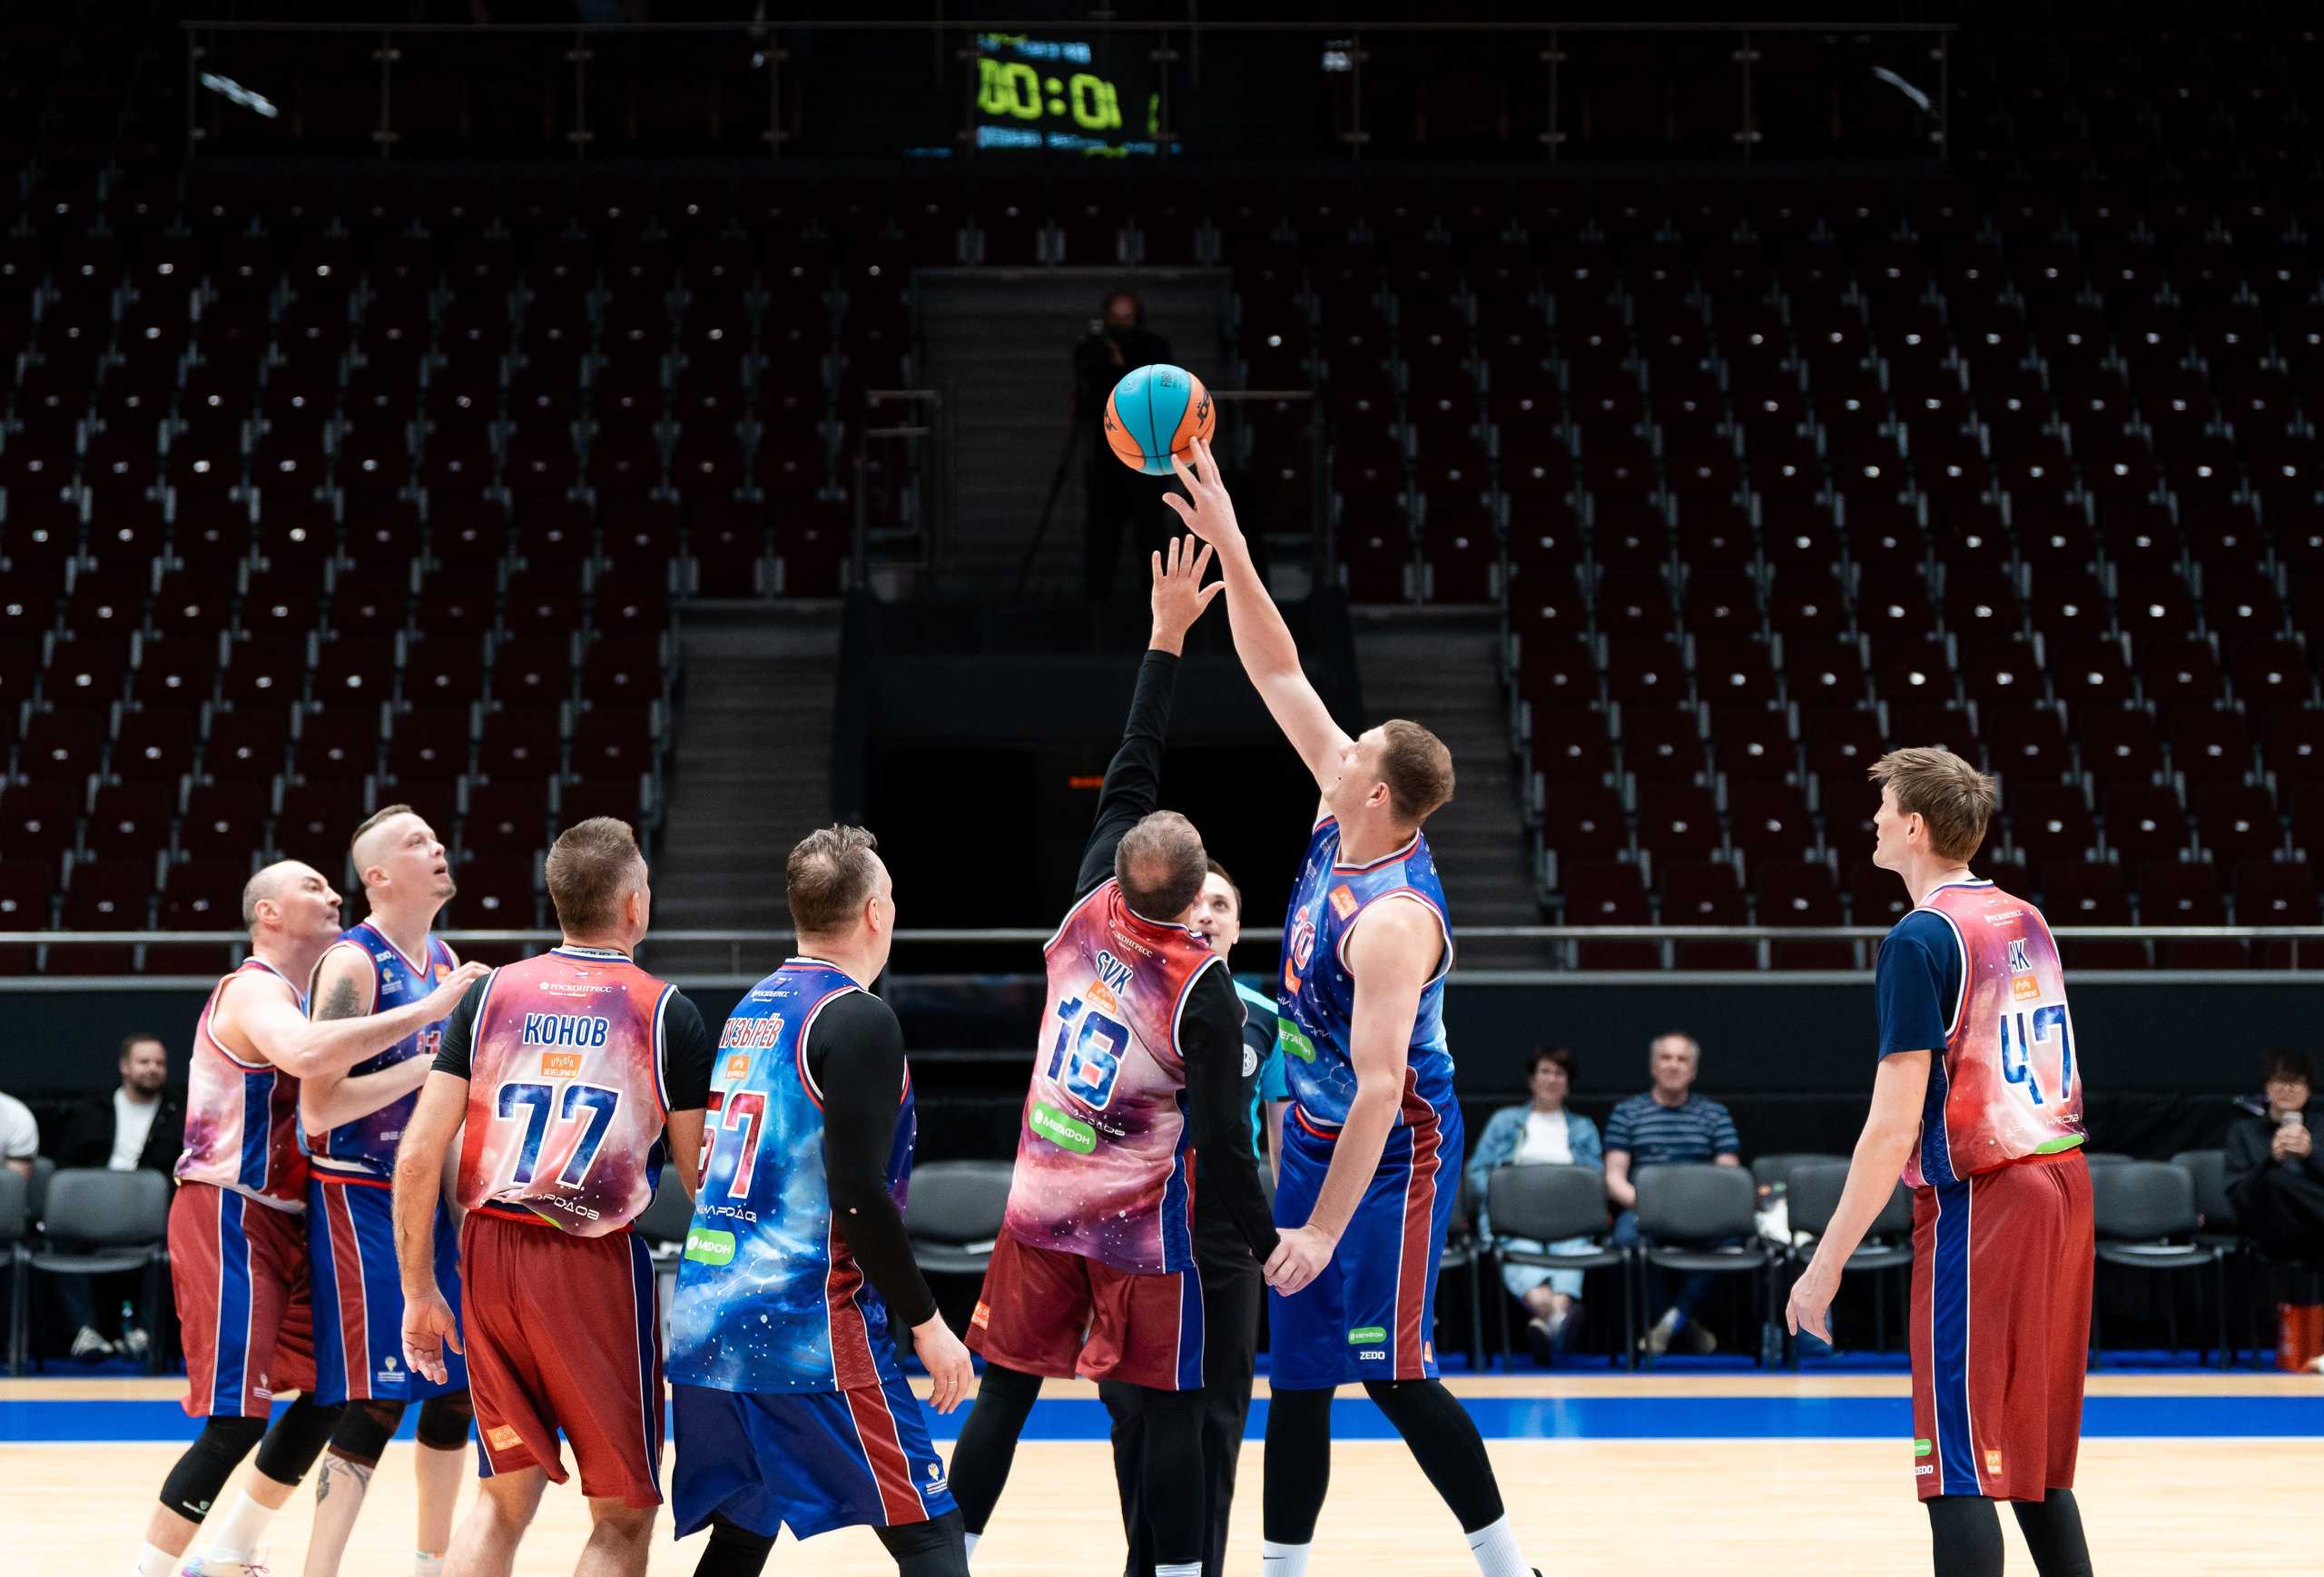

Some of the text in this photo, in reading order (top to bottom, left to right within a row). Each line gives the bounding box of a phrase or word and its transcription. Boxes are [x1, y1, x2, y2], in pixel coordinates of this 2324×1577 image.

[550, 983, 613, 993] РОСКОНГРЕСС
[1096, 950, 1134, 998] SVK
[523, 1012, 610, 1049] КОНОВ
[550, 1055, 574, 1068] VYSOTA
[2000, 1001, 2073, 1108] 47
[543, 1068, 578, 1077] DEVELOPMENT
[496, 1079, 624, 1190] 77
[1042, 1115, 1090, 1146] МЕГАФОН
[1360, 1351, 1385, 1360] ZEDO
